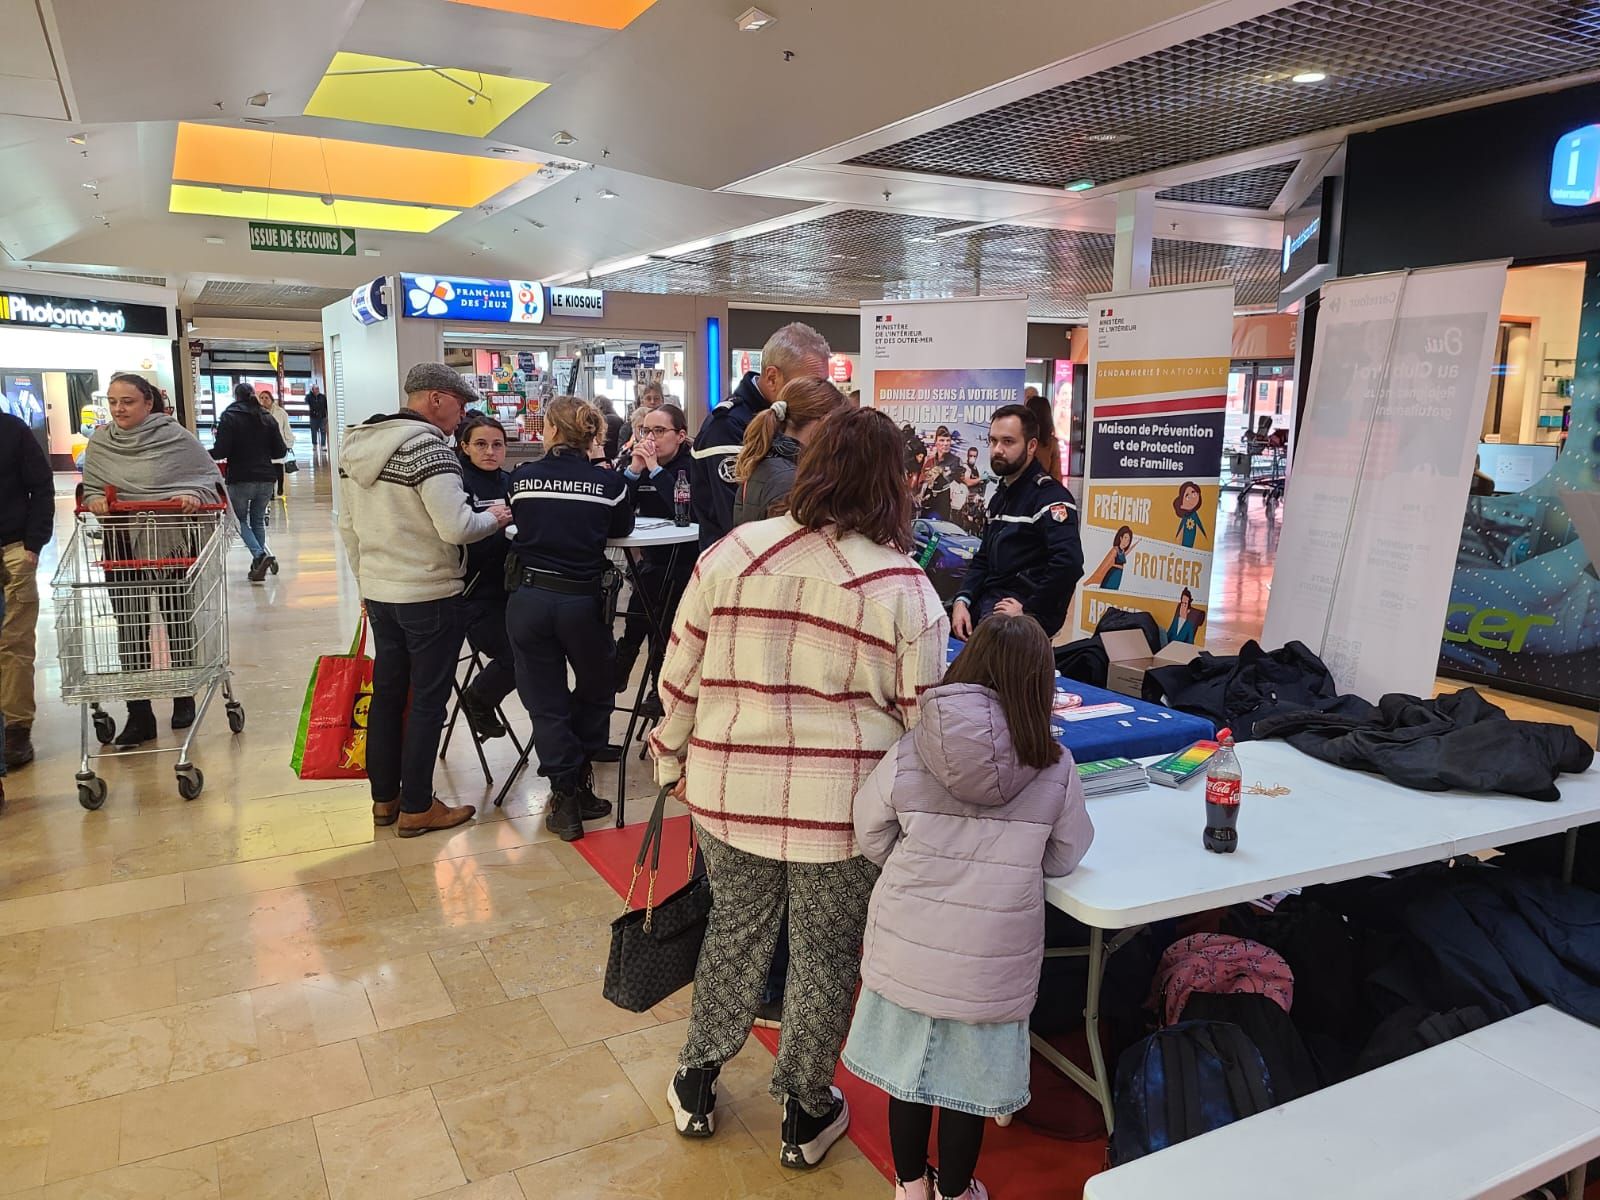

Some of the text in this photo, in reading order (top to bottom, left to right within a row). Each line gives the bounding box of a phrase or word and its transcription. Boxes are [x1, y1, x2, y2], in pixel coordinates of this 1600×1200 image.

[250, 227, 338, 250] ISSUE DE SECOURS
[456, 288, 511, 299] FRANÇAISE
[461, 299, 508, 309] DES JEUX
[552, 294, 602, 309] LE KIOSQUE
[8, 296, 122, 329] Photomaton
[1098, 367, 1224, 377] GENDARMERIE NATIONALE
[880, 387, 1017, 400] DONNEZ DU SENS À VOTRE VIE
[880, 404, 1003, 423] REJOIGNEZ-NOU
[1098, 422, 1214, 438] Maison de Prévention
[1113, 440, 1195, 454] et de Protection
[1120, 456, 1184, 471] des Familles
[513, 479, 604, 495] GENDARMERIE
[1133, 552, 1203, 588] PROTÉGER
